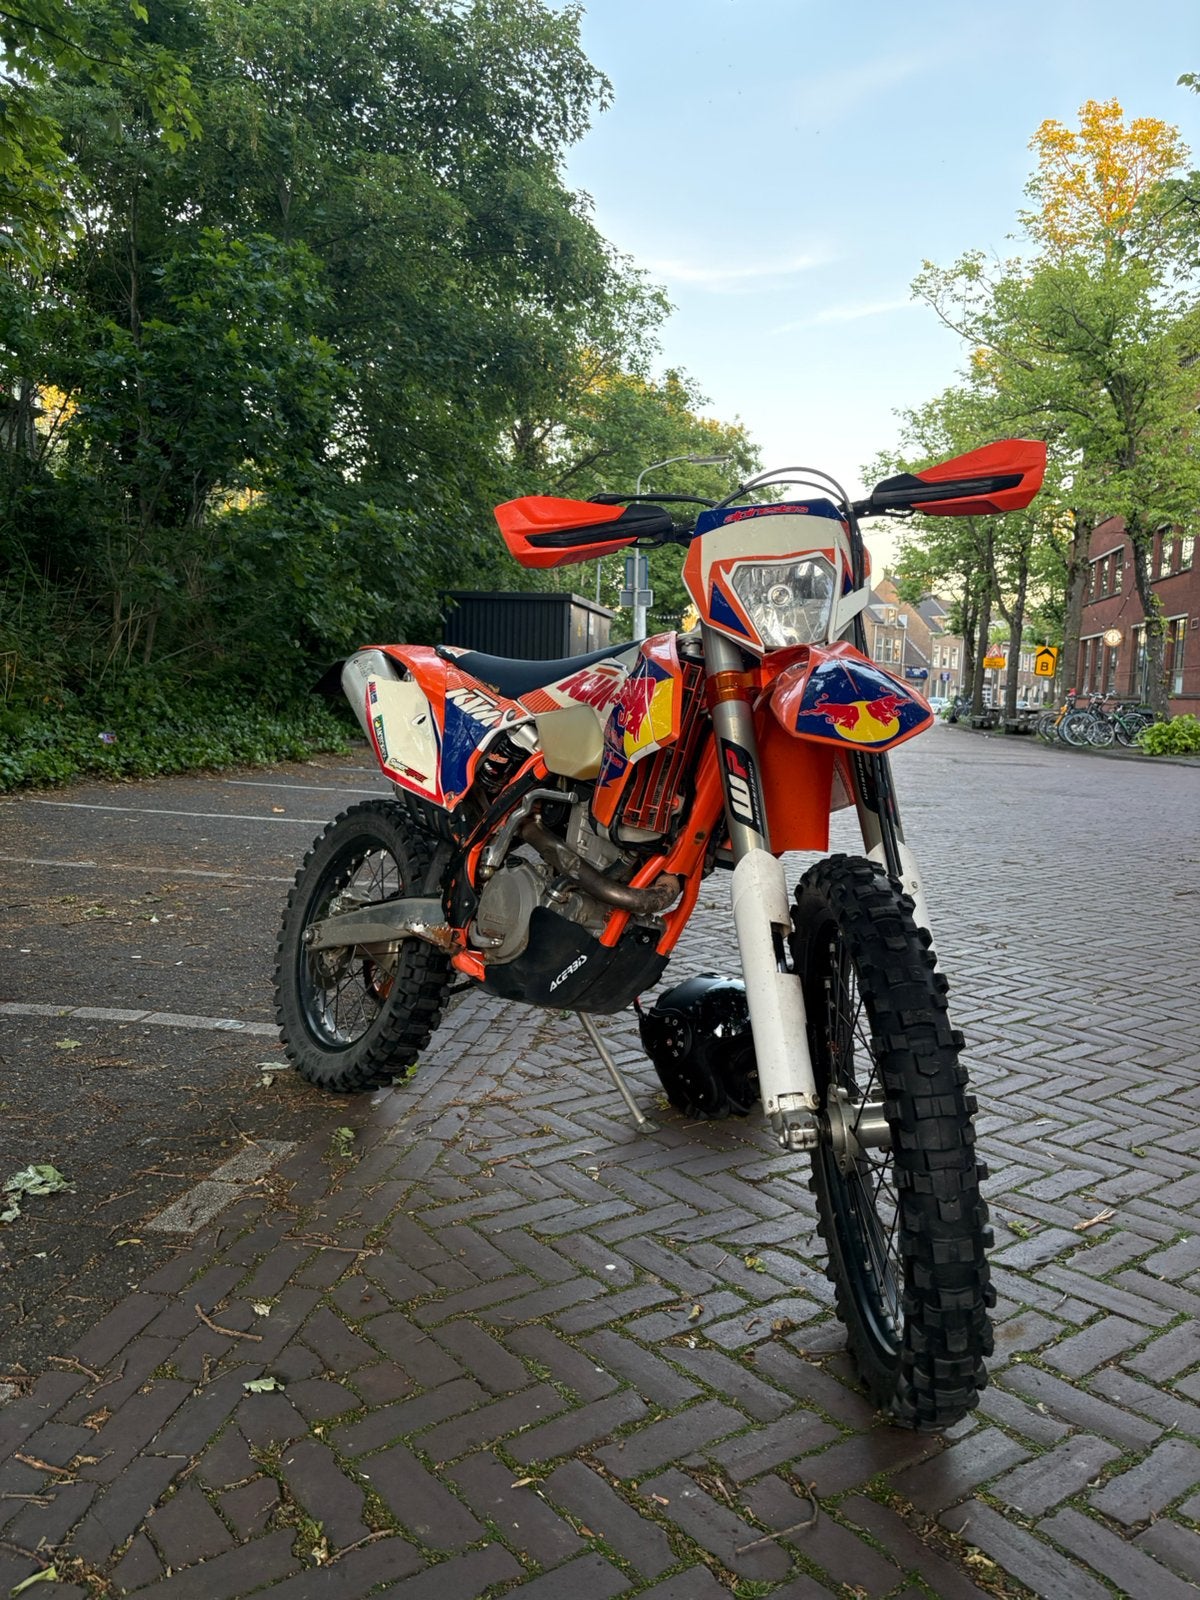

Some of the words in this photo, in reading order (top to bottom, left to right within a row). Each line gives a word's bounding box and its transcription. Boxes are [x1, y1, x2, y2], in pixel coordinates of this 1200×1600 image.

[1041, 662, 1049, 671] B
[445, 688, 503, 727] KTM
[549, 954, 588, 992] ACERBIS
